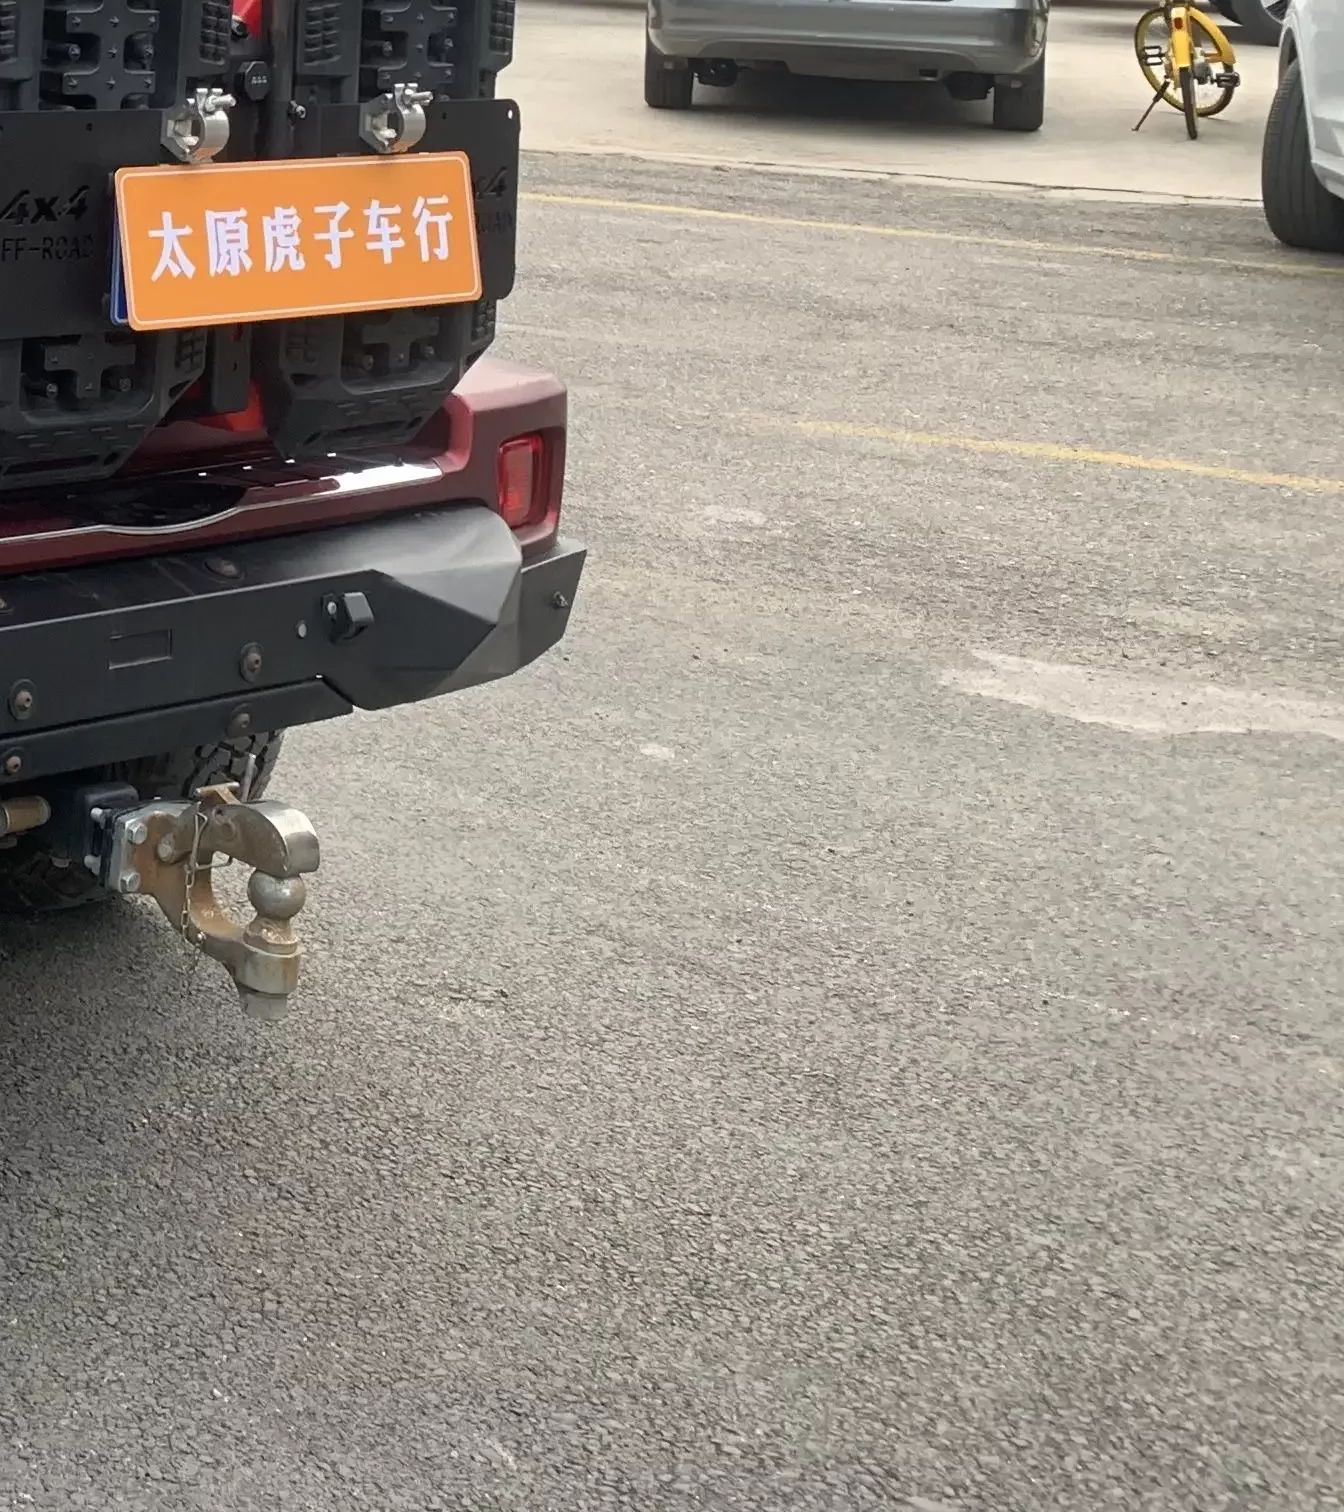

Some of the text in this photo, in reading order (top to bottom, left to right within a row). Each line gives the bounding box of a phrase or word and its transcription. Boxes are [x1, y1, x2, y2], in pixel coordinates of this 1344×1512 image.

[147, 193, 455, 282] 太原虎子车行
